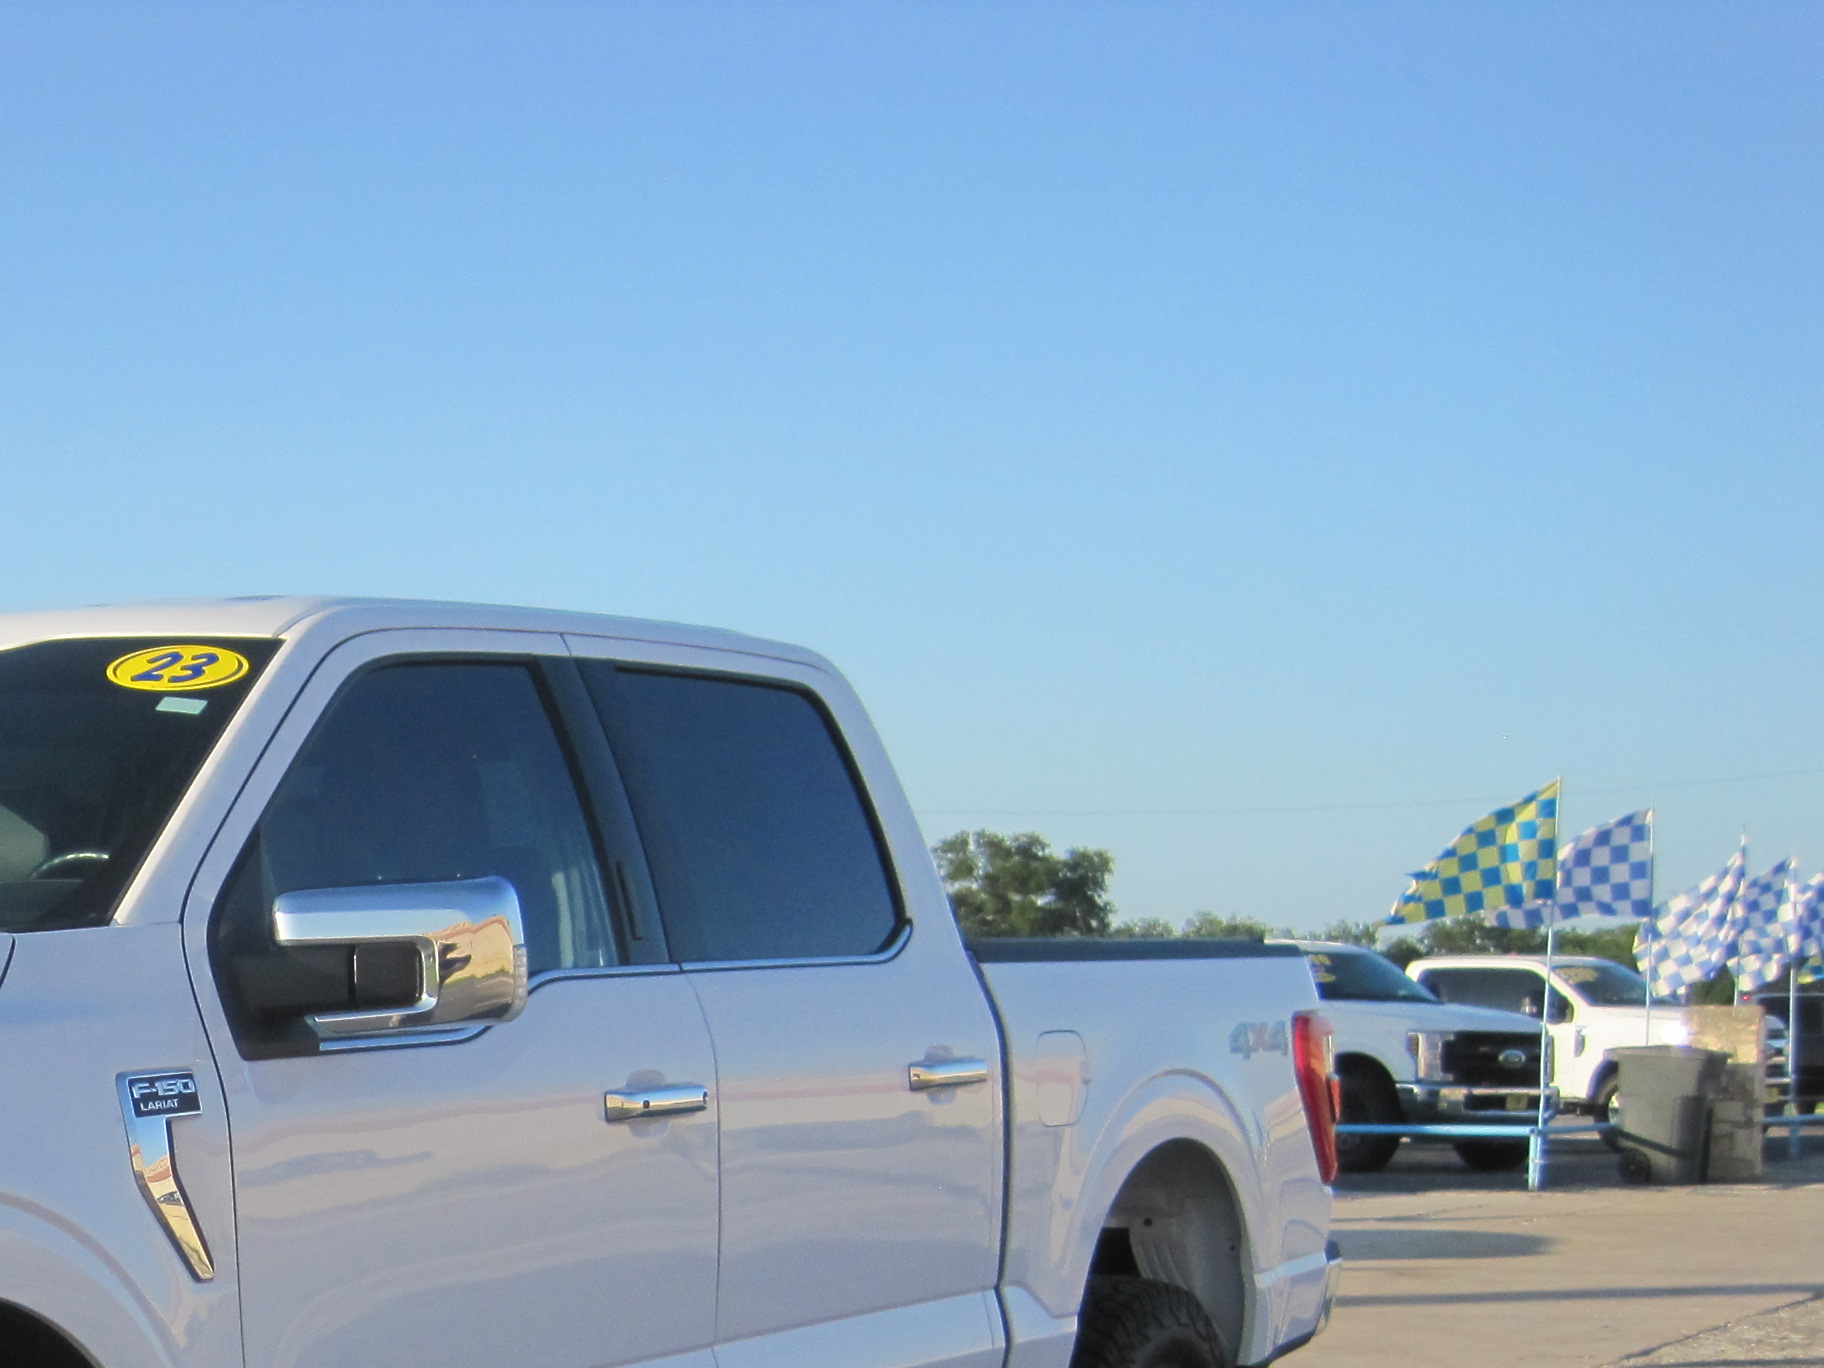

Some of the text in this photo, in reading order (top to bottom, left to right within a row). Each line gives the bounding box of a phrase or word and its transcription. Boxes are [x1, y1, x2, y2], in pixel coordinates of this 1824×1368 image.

[131, 651, 219, 682] 23
[133, 1079, 195, 1098] F-150
[141, 1099, 178, 1111] LARIAT
